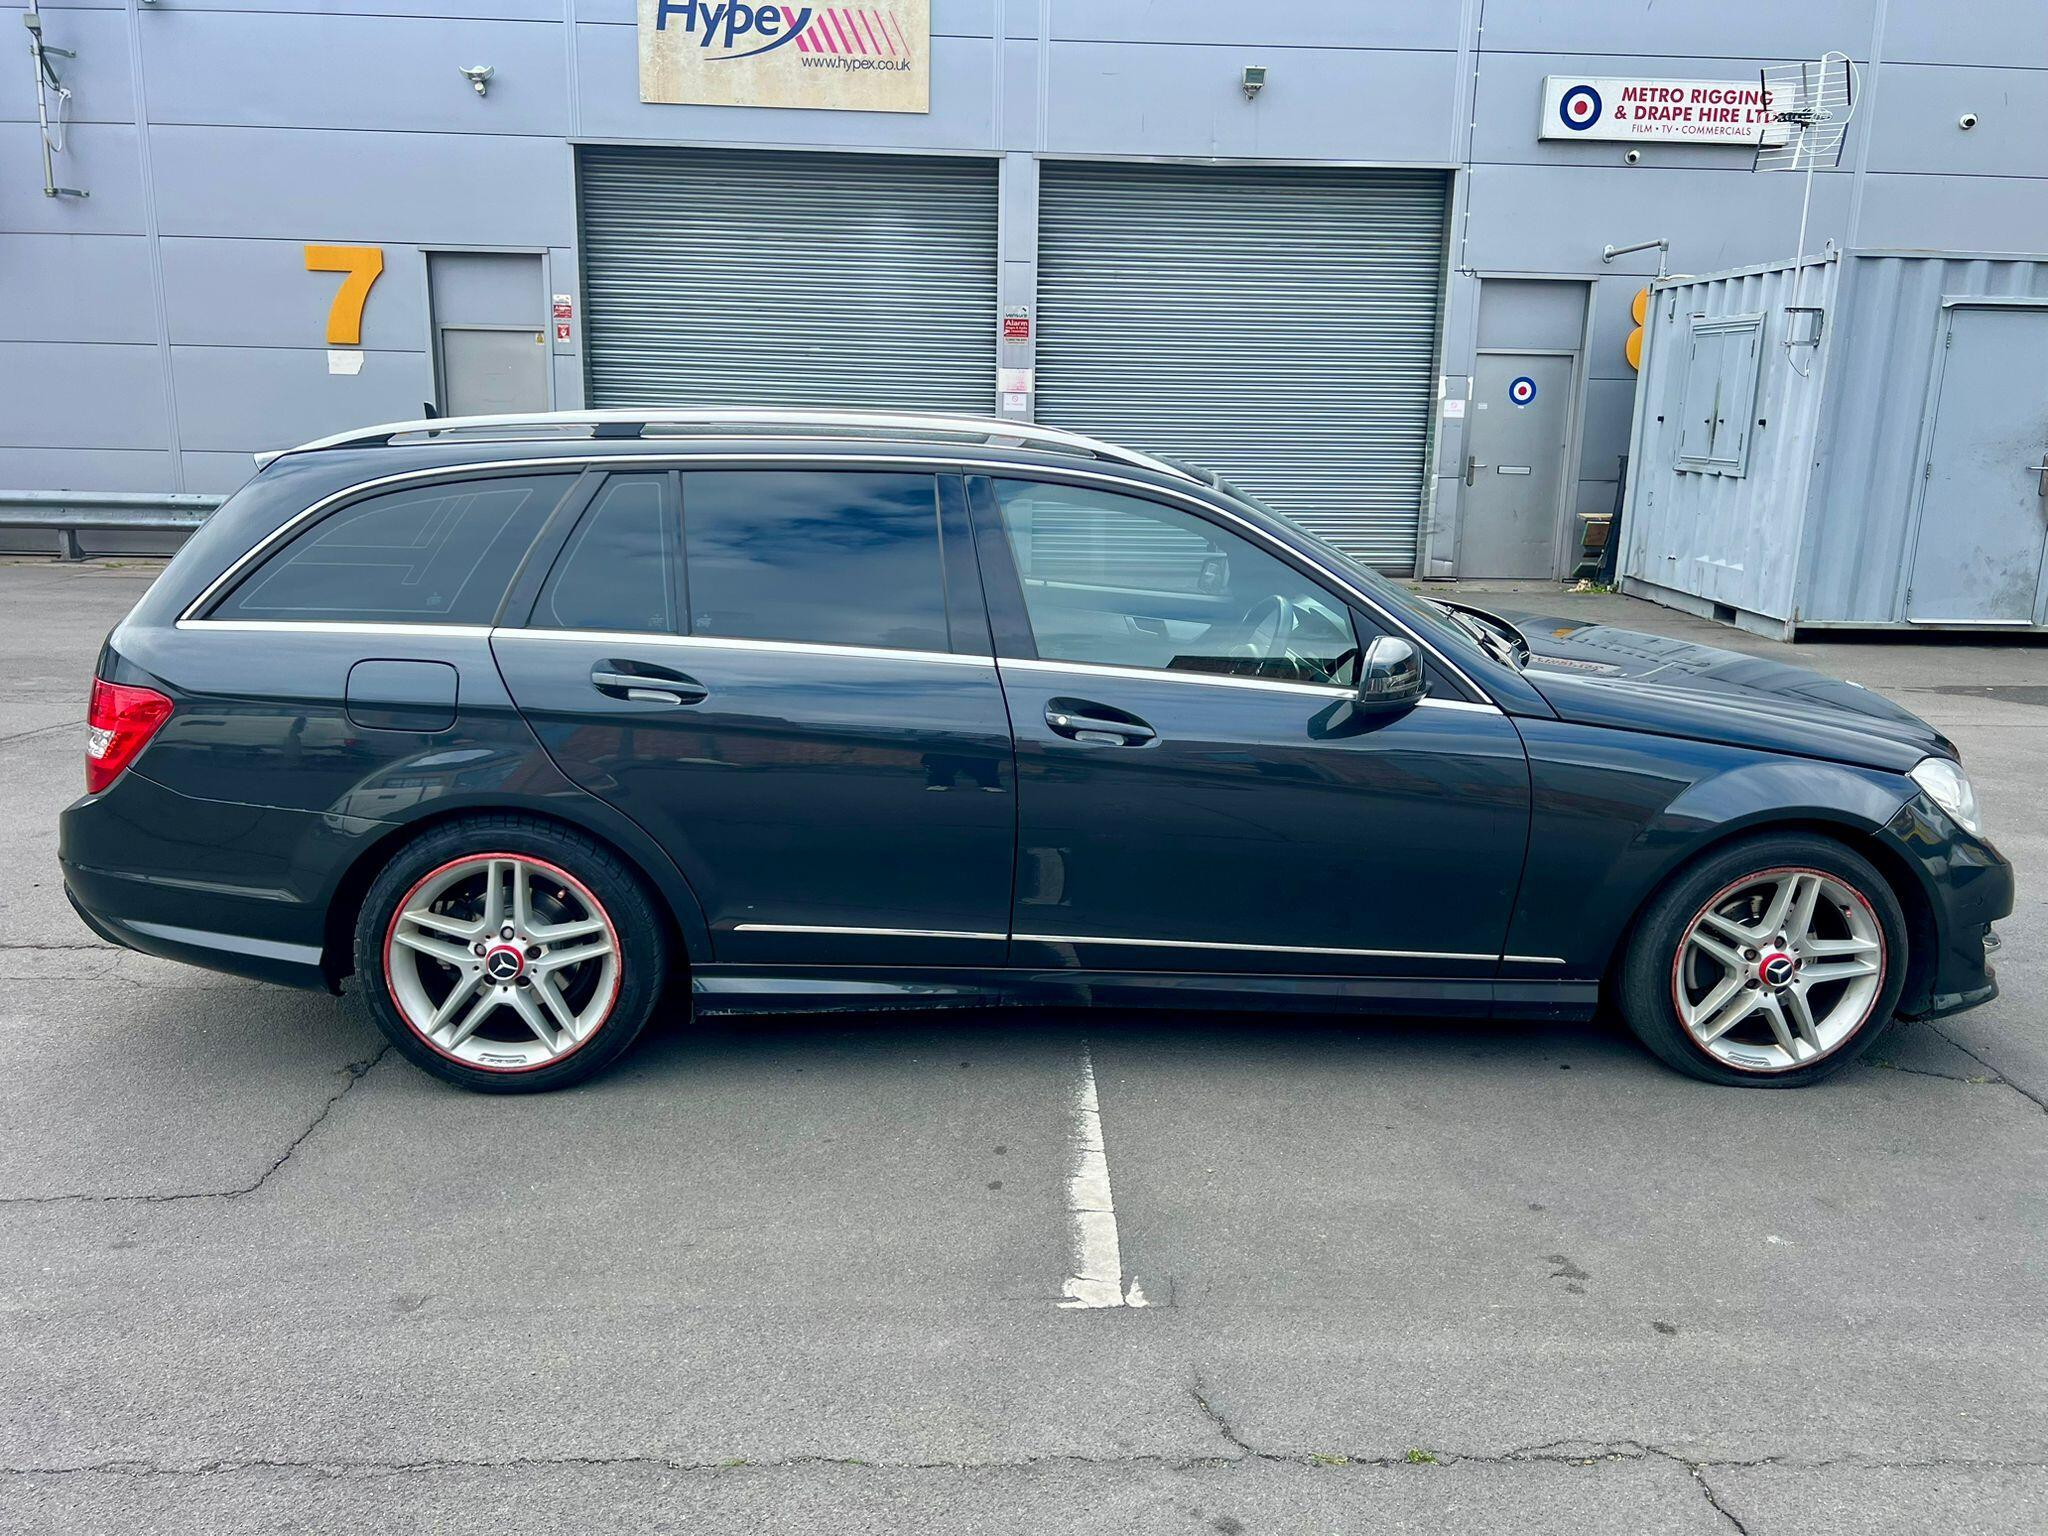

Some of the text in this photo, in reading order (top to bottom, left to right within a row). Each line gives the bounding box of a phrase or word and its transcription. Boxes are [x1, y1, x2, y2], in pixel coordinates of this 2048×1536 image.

[655, 0, 812, 53] Hypex
[801, 56, 911, 72] www.hypex.co.uk
[1621, 87, 1774, 105] METRO RIGGING
[1614, 105, 1627, 120] &
[1634, 106, 1692, 121] DRAPE
[1698, 108, 1740, 122] HIRE
[1631, 124, 1752, 136] FILM TV COMMERCIALS
[304, 245, 384, 345] 7
